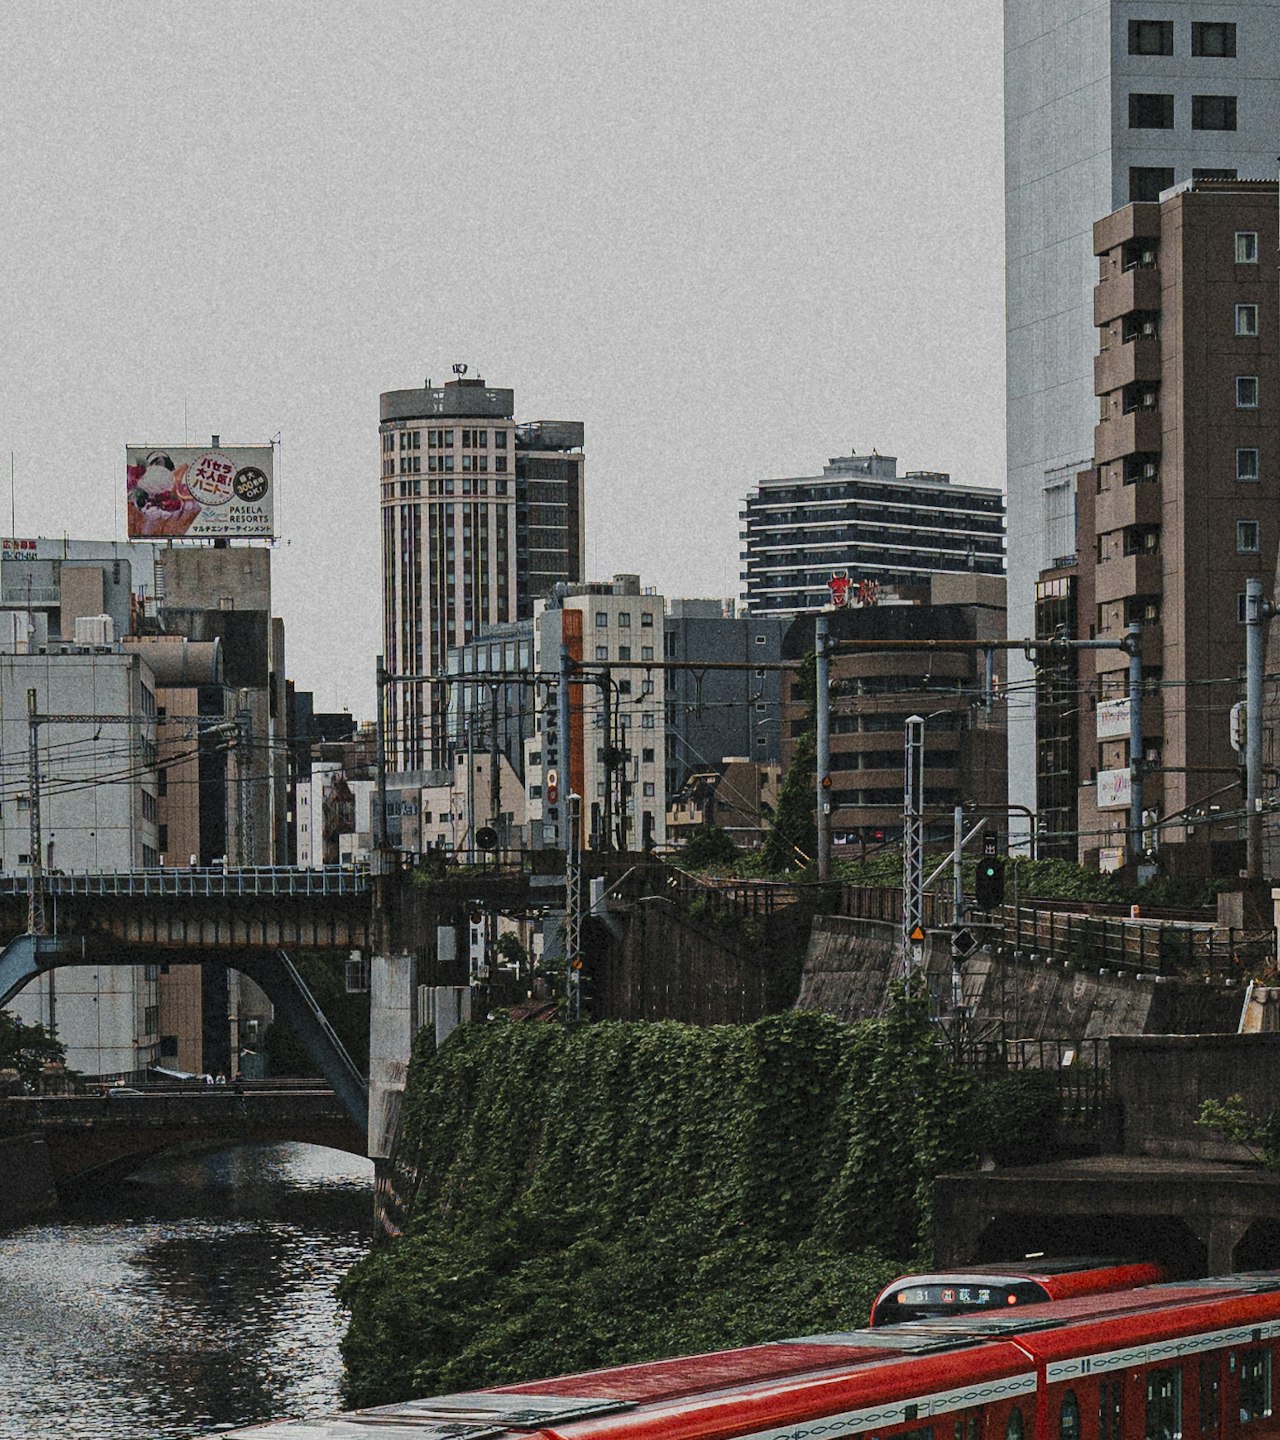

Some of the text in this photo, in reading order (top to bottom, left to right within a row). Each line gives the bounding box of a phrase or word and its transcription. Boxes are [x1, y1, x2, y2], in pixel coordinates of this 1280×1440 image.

[229, 506, 263, 514] PASELA
[229, 515, 269, 523] RESORTS
[916, 1290, 929, 1301] 31
